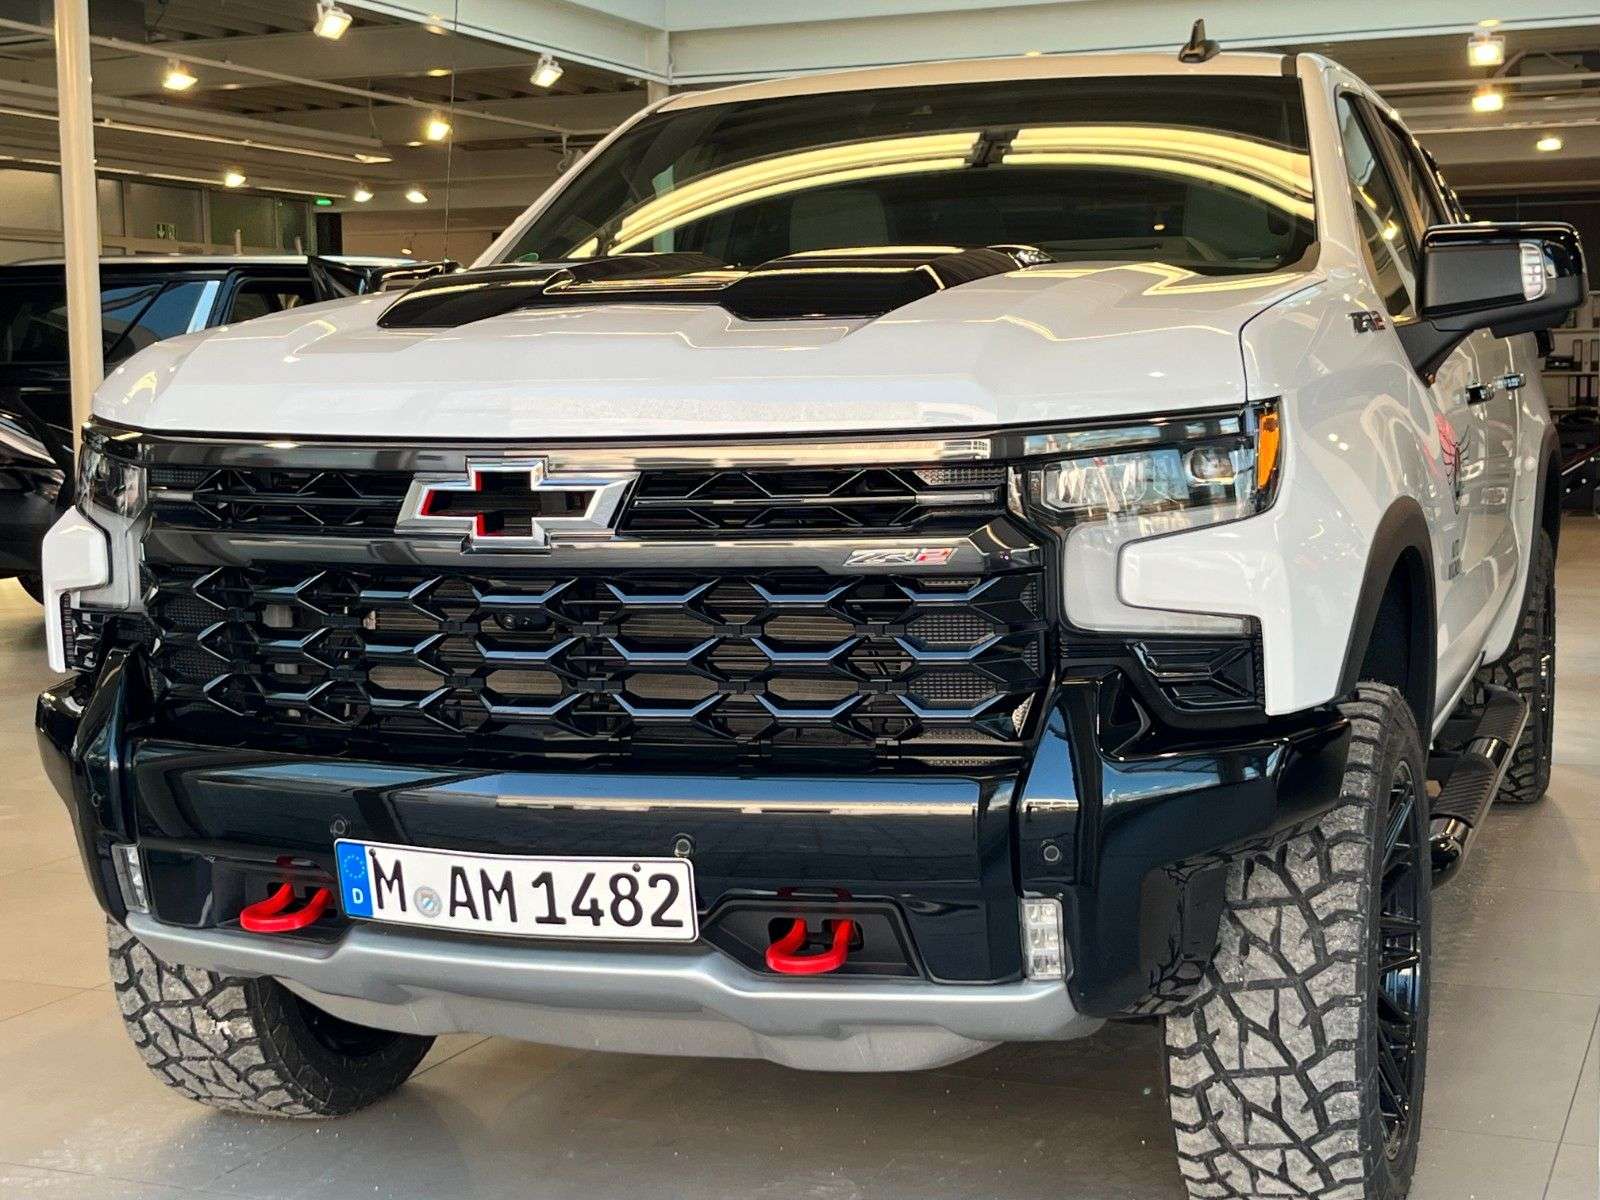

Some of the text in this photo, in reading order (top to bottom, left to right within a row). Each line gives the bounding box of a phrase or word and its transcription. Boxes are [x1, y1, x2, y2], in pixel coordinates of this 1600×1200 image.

[352, 887, 364, 905] D
[371, 855, 684, 928] M AM 1482
